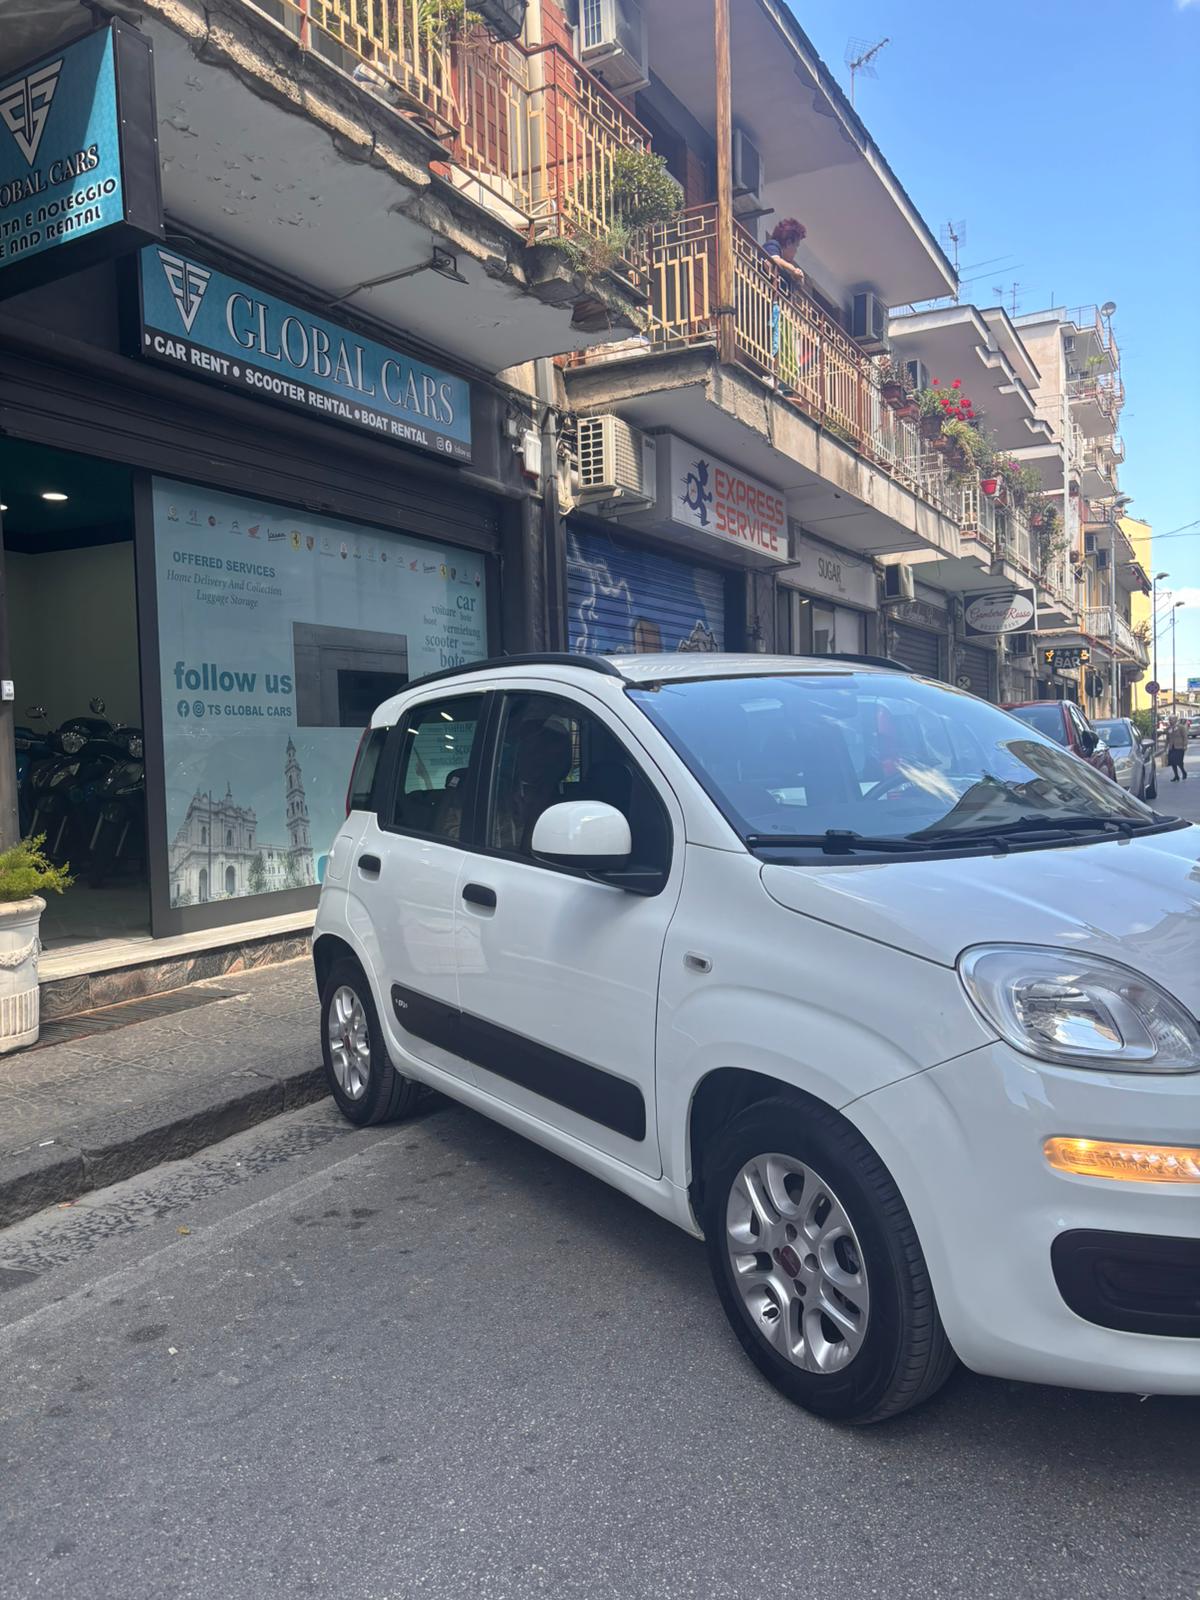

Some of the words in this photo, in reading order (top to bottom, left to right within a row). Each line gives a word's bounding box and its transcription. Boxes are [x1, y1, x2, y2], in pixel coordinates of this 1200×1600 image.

[49, 145, 99, 185] CARS
[26, 213, 32, 227] E
[38, 179, 116, 222] NOLEGGIO
[11, 231, 40, 254] AND
[47, 206, 101, 239] RENTAL
[226, 292, 375, 396] GLOBAL
[381, 359, 454, 425] CARS
[154, 336, 187, 361] CAR
[191, 349, 229, 375] RENT
[245, 369, 306, 402] SCOOTER
[308, 391, 352, 419] RENTAL
[361, 410, 388, 431] BOAT
[391, 420, 428, 445] RENTAL
[715, 468, 784, 526] EXPRESS
[716, 502, 778, 552] SERVICE
[173, 551, 223, 569] OFFERED
[226, 559, 276, 578] SERVICES
[818, 557, 841, 584] SUGAR
[167, 569, 192, 584] Home
[193, 573, 227, 590] Delivery
[228, 579, 245, 591] And
[246, 581, 282, 596] Collection
[196, 589, 229, 606] Luggage
[230, 594, 258, 609] Storage
[456, 595, 476, 611] car
[424, 635, 460, 649] scooter
[1054, 656, 1081, 668] BAR
[174, 661, 257, 692] follow
[265, 674, 293, 694] us
[207, 704, 222, 716] TS
[224, 705, 265, 717] GLOBAL
[266, 707, 293, 717] CARS
